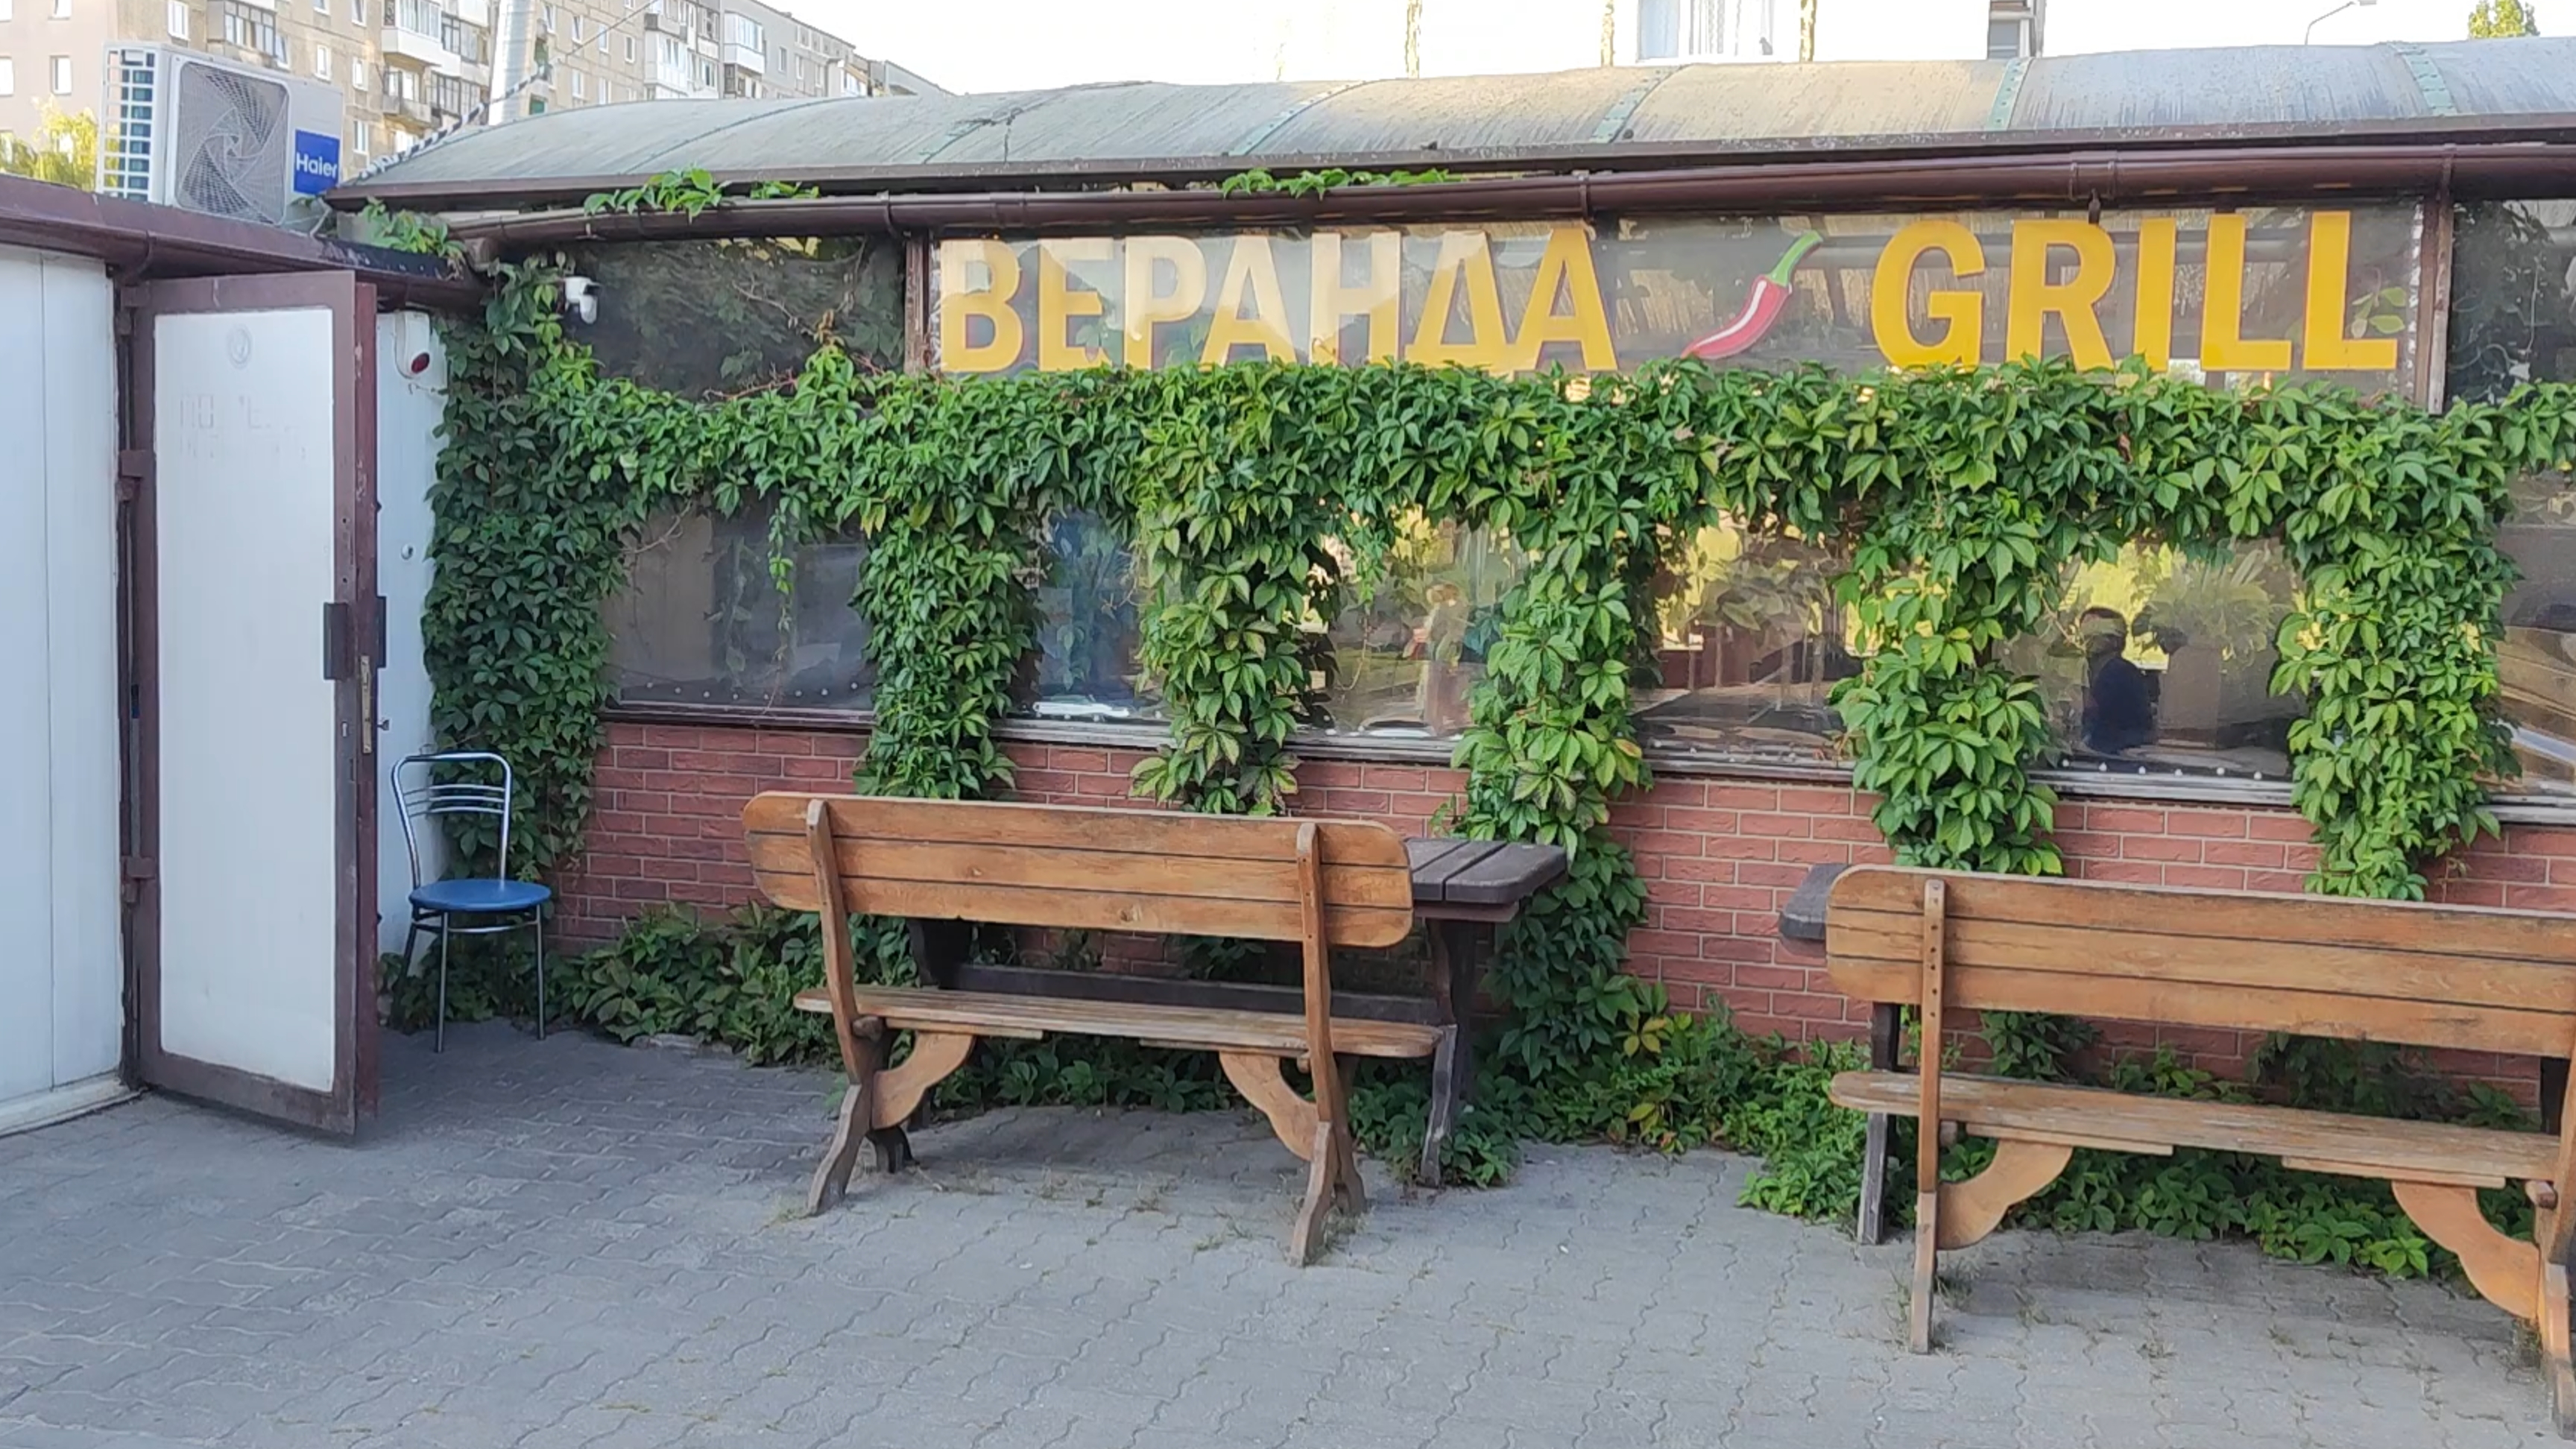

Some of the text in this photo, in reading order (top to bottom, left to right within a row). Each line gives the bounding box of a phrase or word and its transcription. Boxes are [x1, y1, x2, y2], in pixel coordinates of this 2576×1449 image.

[296, 151, 338, 179] Haier
[939, 210, 2398, 375] ВЕРАНДА GRILL
